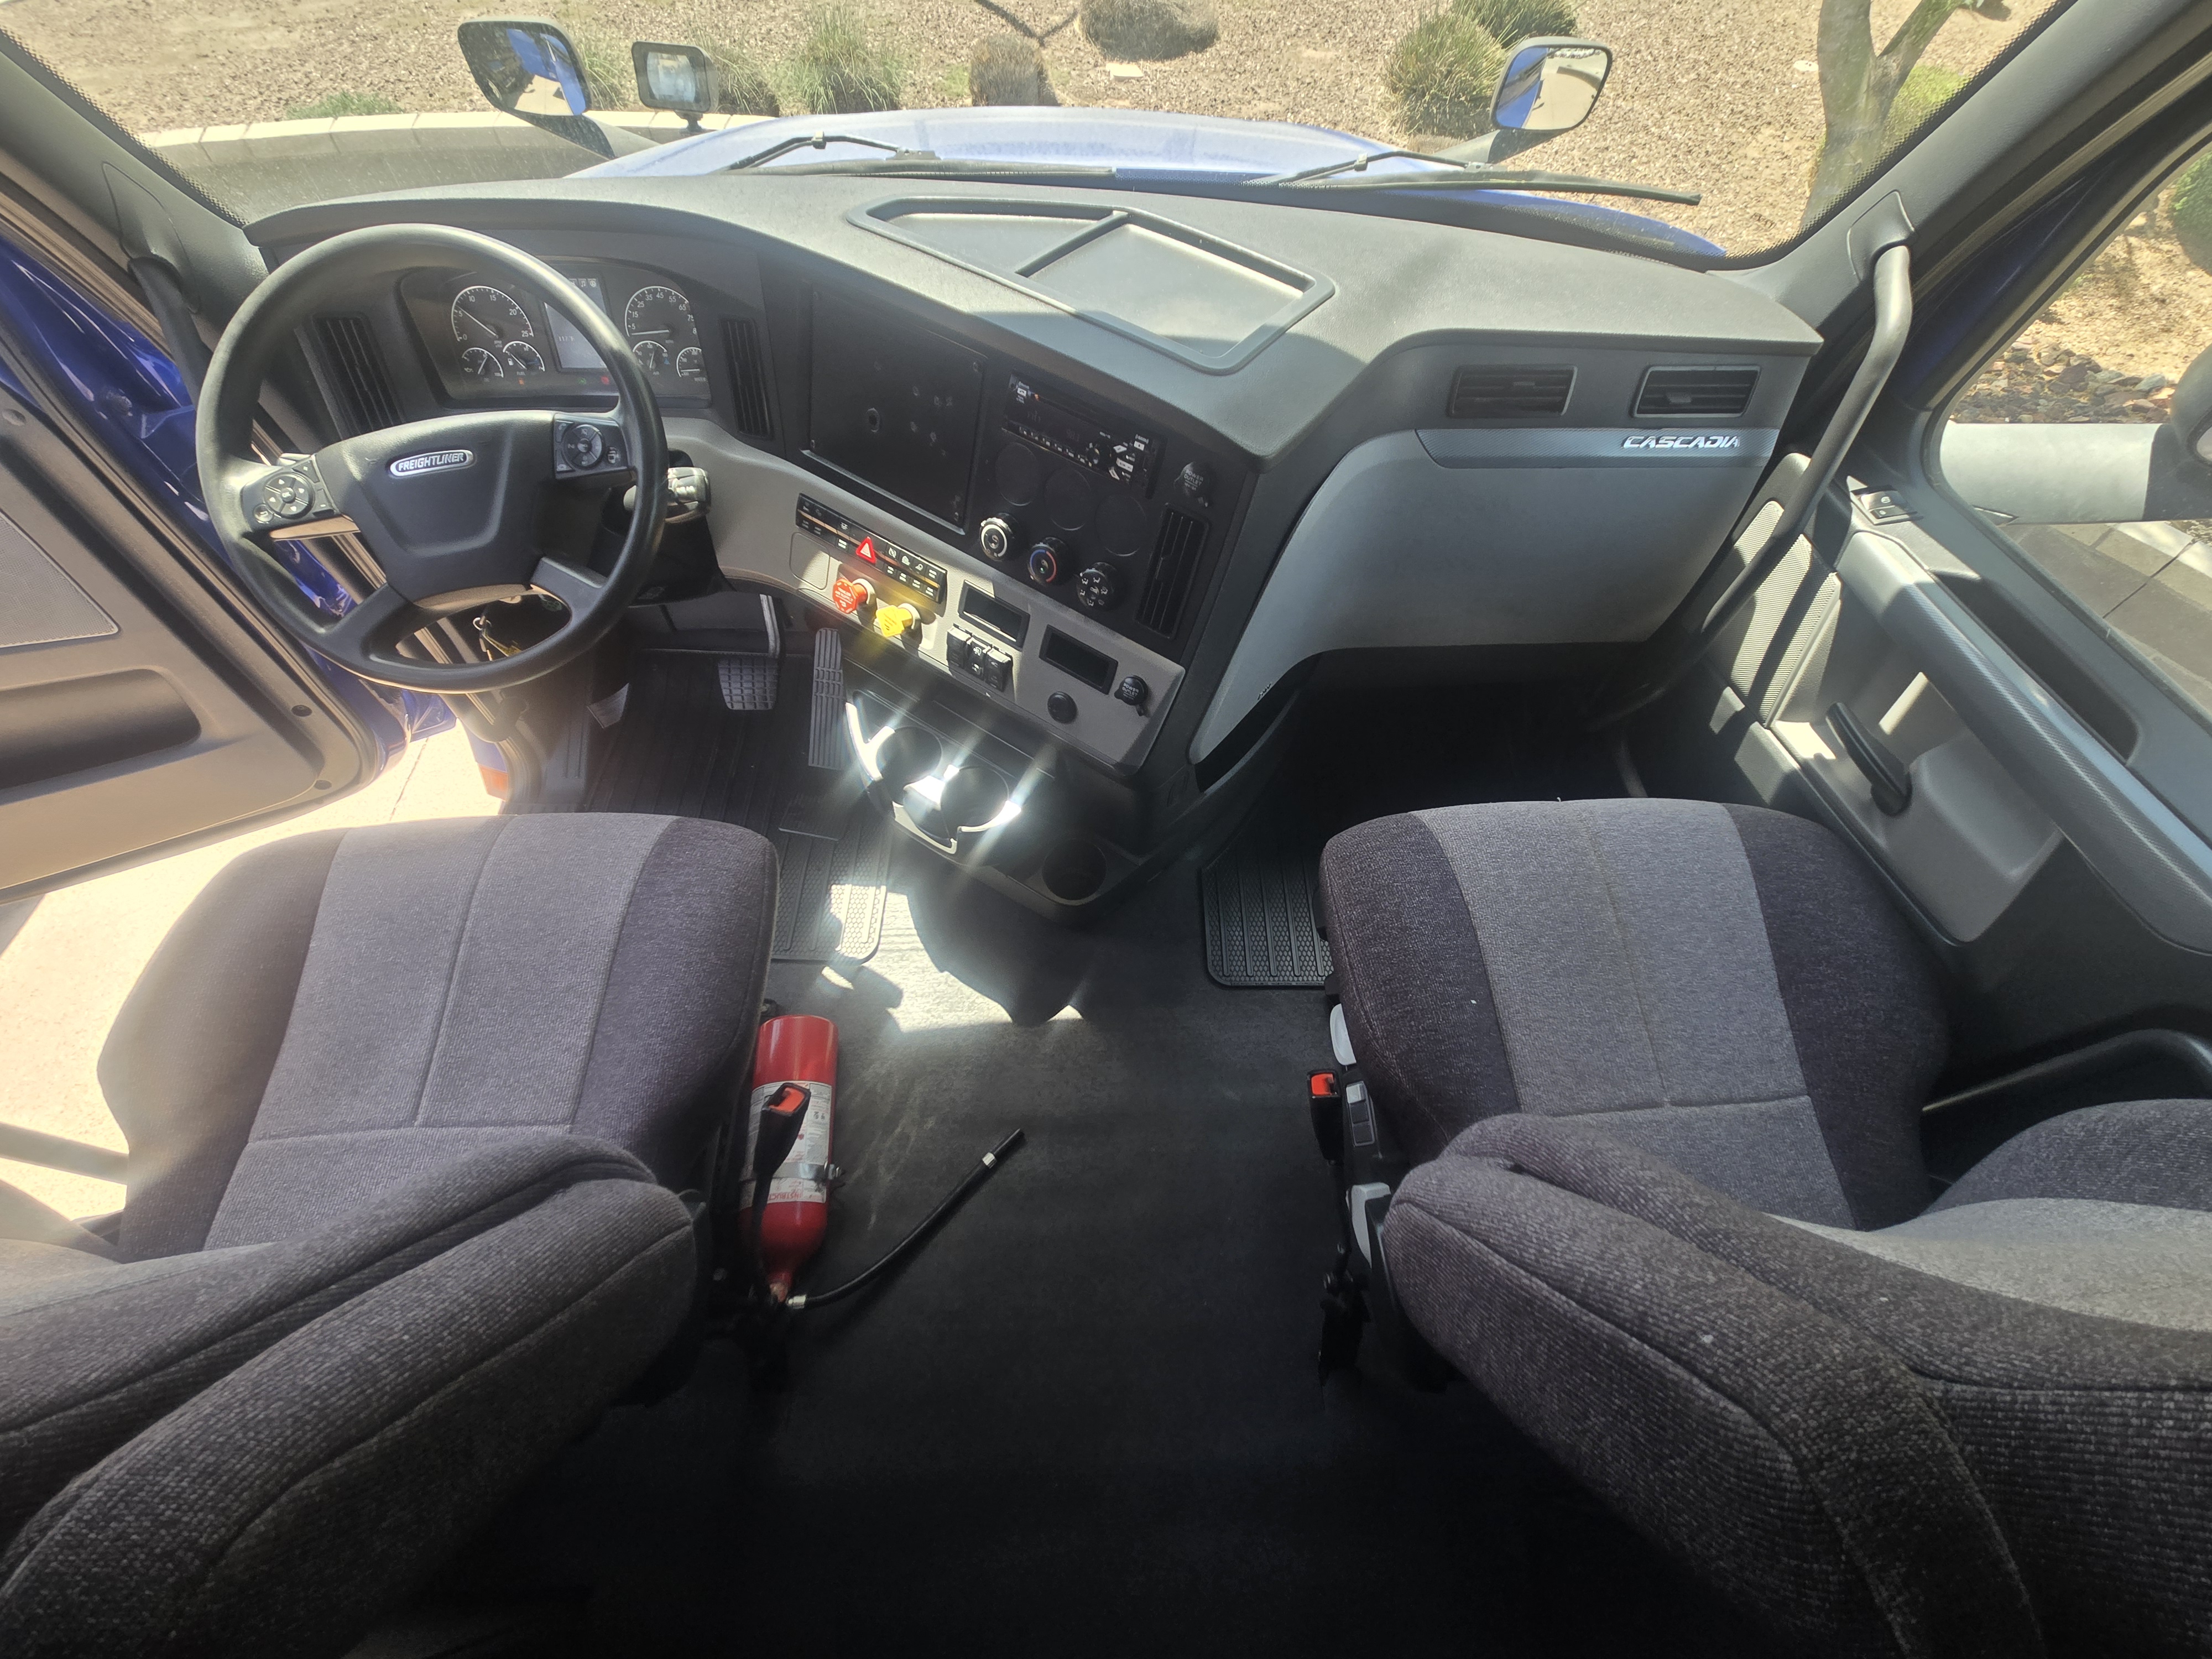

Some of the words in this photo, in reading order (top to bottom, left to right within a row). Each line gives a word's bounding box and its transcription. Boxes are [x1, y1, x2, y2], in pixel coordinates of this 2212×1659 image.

[1623, 435, 1740, 449] CASCADIA
[398, 452, 464, 471] FREIGHTLINER
[1184, 474, 1202, 486] OUTLET
[1186, 469, 1204, 482] POWER
[1122, 687, 1138, 697] OUTLET
[1123, 683, 1139, 693] POWER
